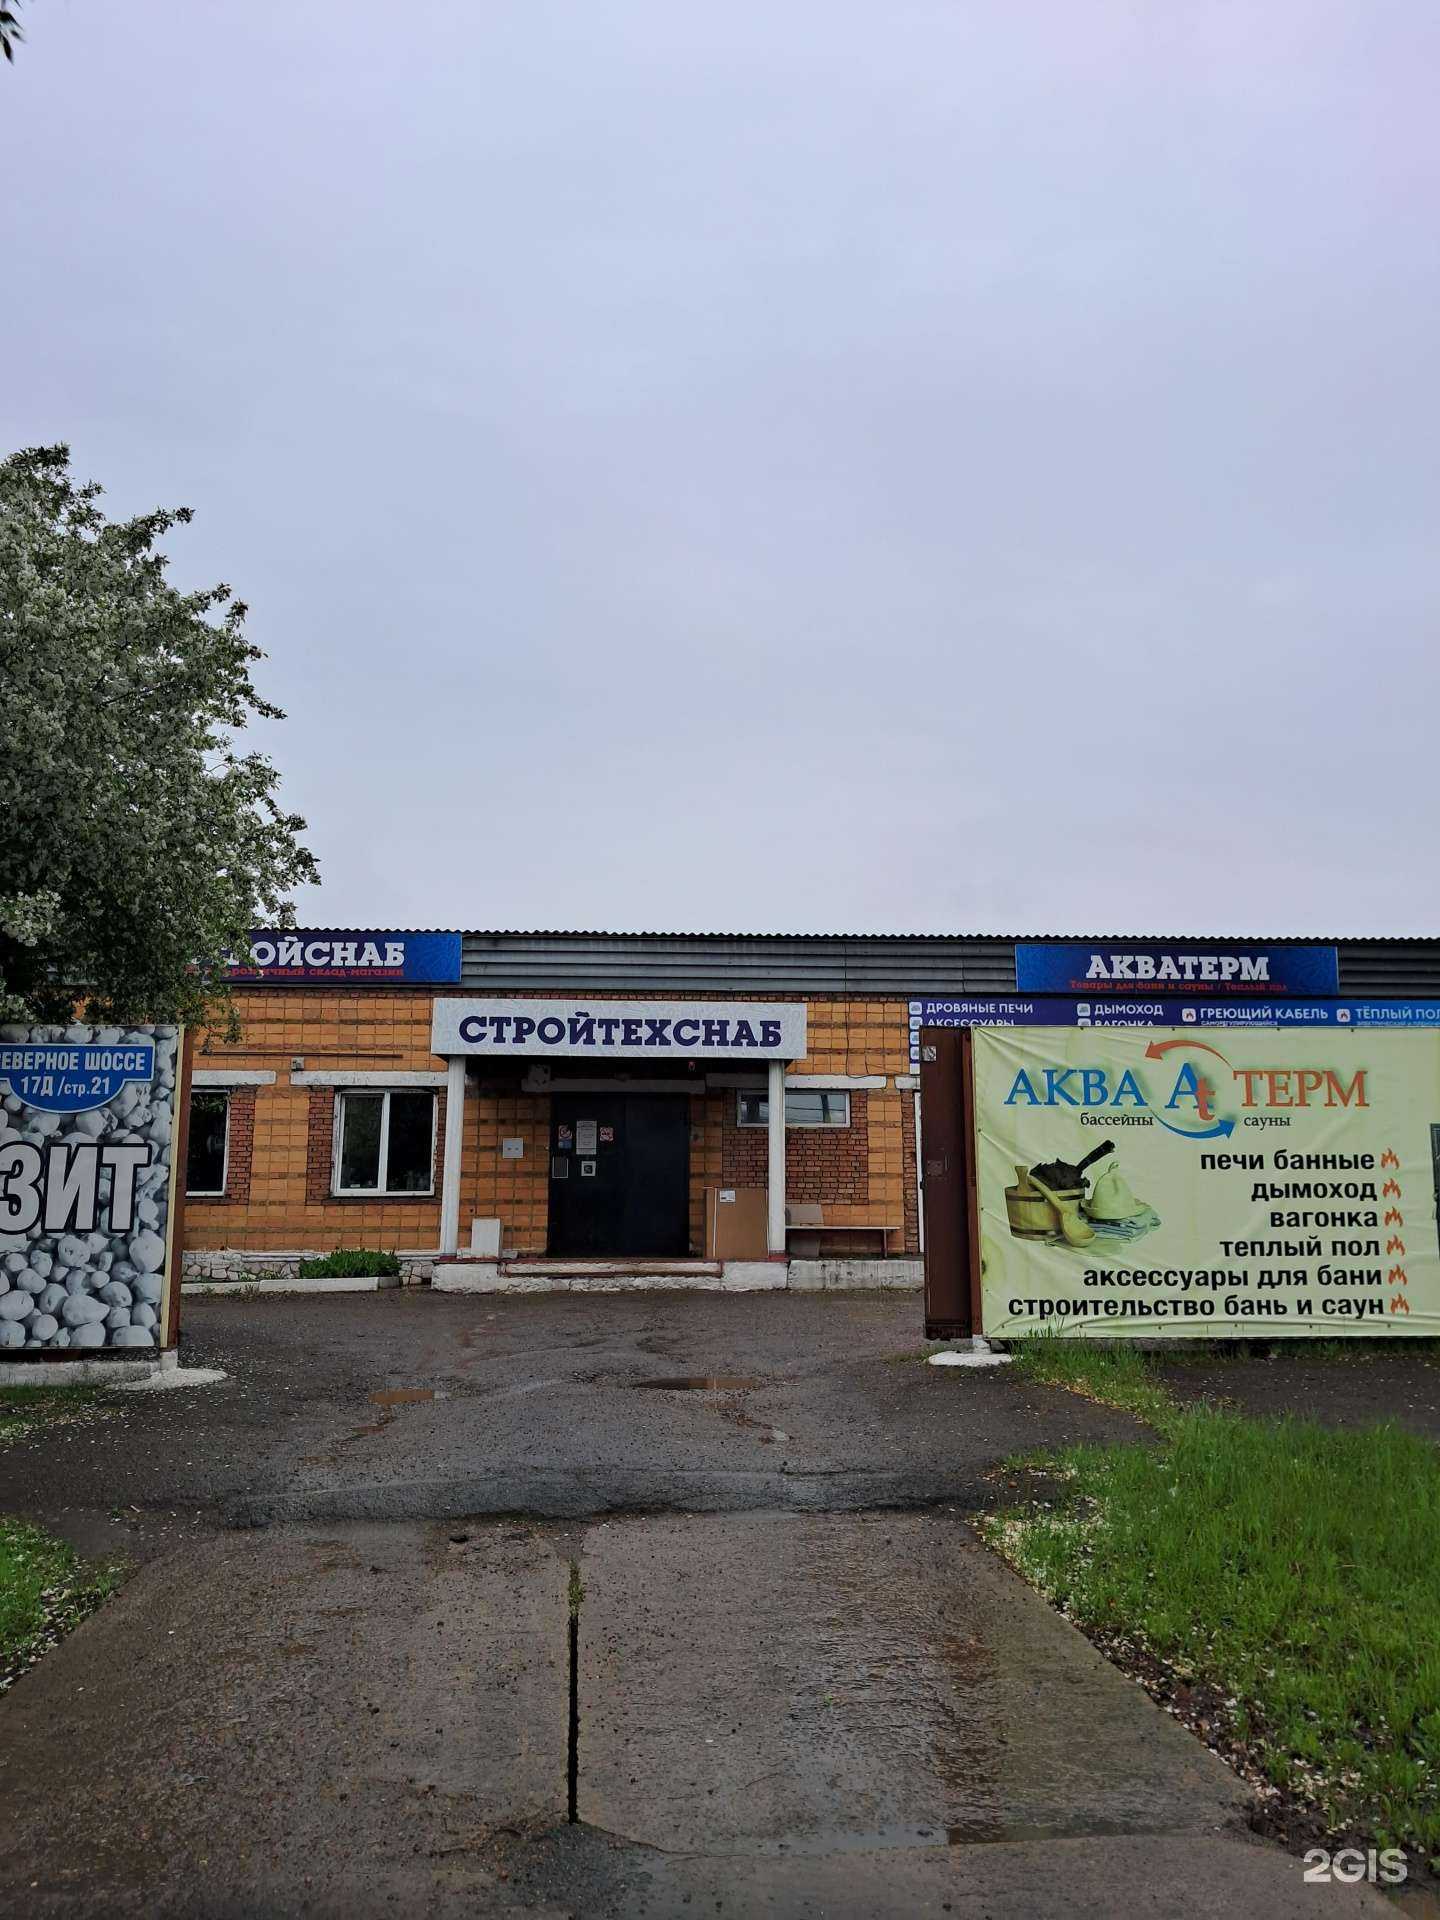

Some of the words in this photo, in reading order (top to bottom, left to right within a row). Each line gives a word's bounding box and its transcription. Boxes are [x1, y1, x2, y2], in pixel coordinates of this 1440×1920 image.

[1086, 955, 1270, 980] АКВАТЕРМ
[926, 1002, 995, 1014] ДРОВЯНЫЕ
[999, 1004, 1033, 1013] ПЕЧИ
[1095, 1004, 1163, 1016] ДЫМОХОД
[1200, 1005, 1272, 1020] ГРЕЮЩИЙ
[1275, 1009, 1328, 1019] КАБЕЛЬ
[1355, 1006, 1412, 1019] ТЁПЛЫЙ
[459, 1011, 782, 1047] СТРОЙТЕХСНАБ
[0, 1051, 79, 1070] ЕВЕРНОЕ
[84, 1051, 145, 1071] ШОССЕ
[21, 1076, 54, 1097] 17Д
[1004, 1067, 1148, 1107] АКВА
[1233, 1069, 1370, 1107] ТЕРМ
[1080, 1110, 1154, 1127] бассейны
[1244, 1115, 1291, 1128] сауны
[1200, 1153, 1266, 1169] печи
[1274, 1149, 1375, 1170] банные
[1251, 1182, 1378, 1202] дымоход
[1270, 1211, 1379, 1227] вагонка
[1220, 1236, 1322, 1256] теплый
[1331, 1240, 1380, 1256] пол
[1083, 1270, 1249, 1292] аксессуары
[1257, 1270, 1311, 1288] для
[1317, 1266, 1383, 1285] бани
[1008, 1299, 1215, 1319] строительство
[1223, 1295, 1287, 1316] бань
[1297, 1299, 1313, 1315] и
[1322, 1299, 1385, 1319] саун
